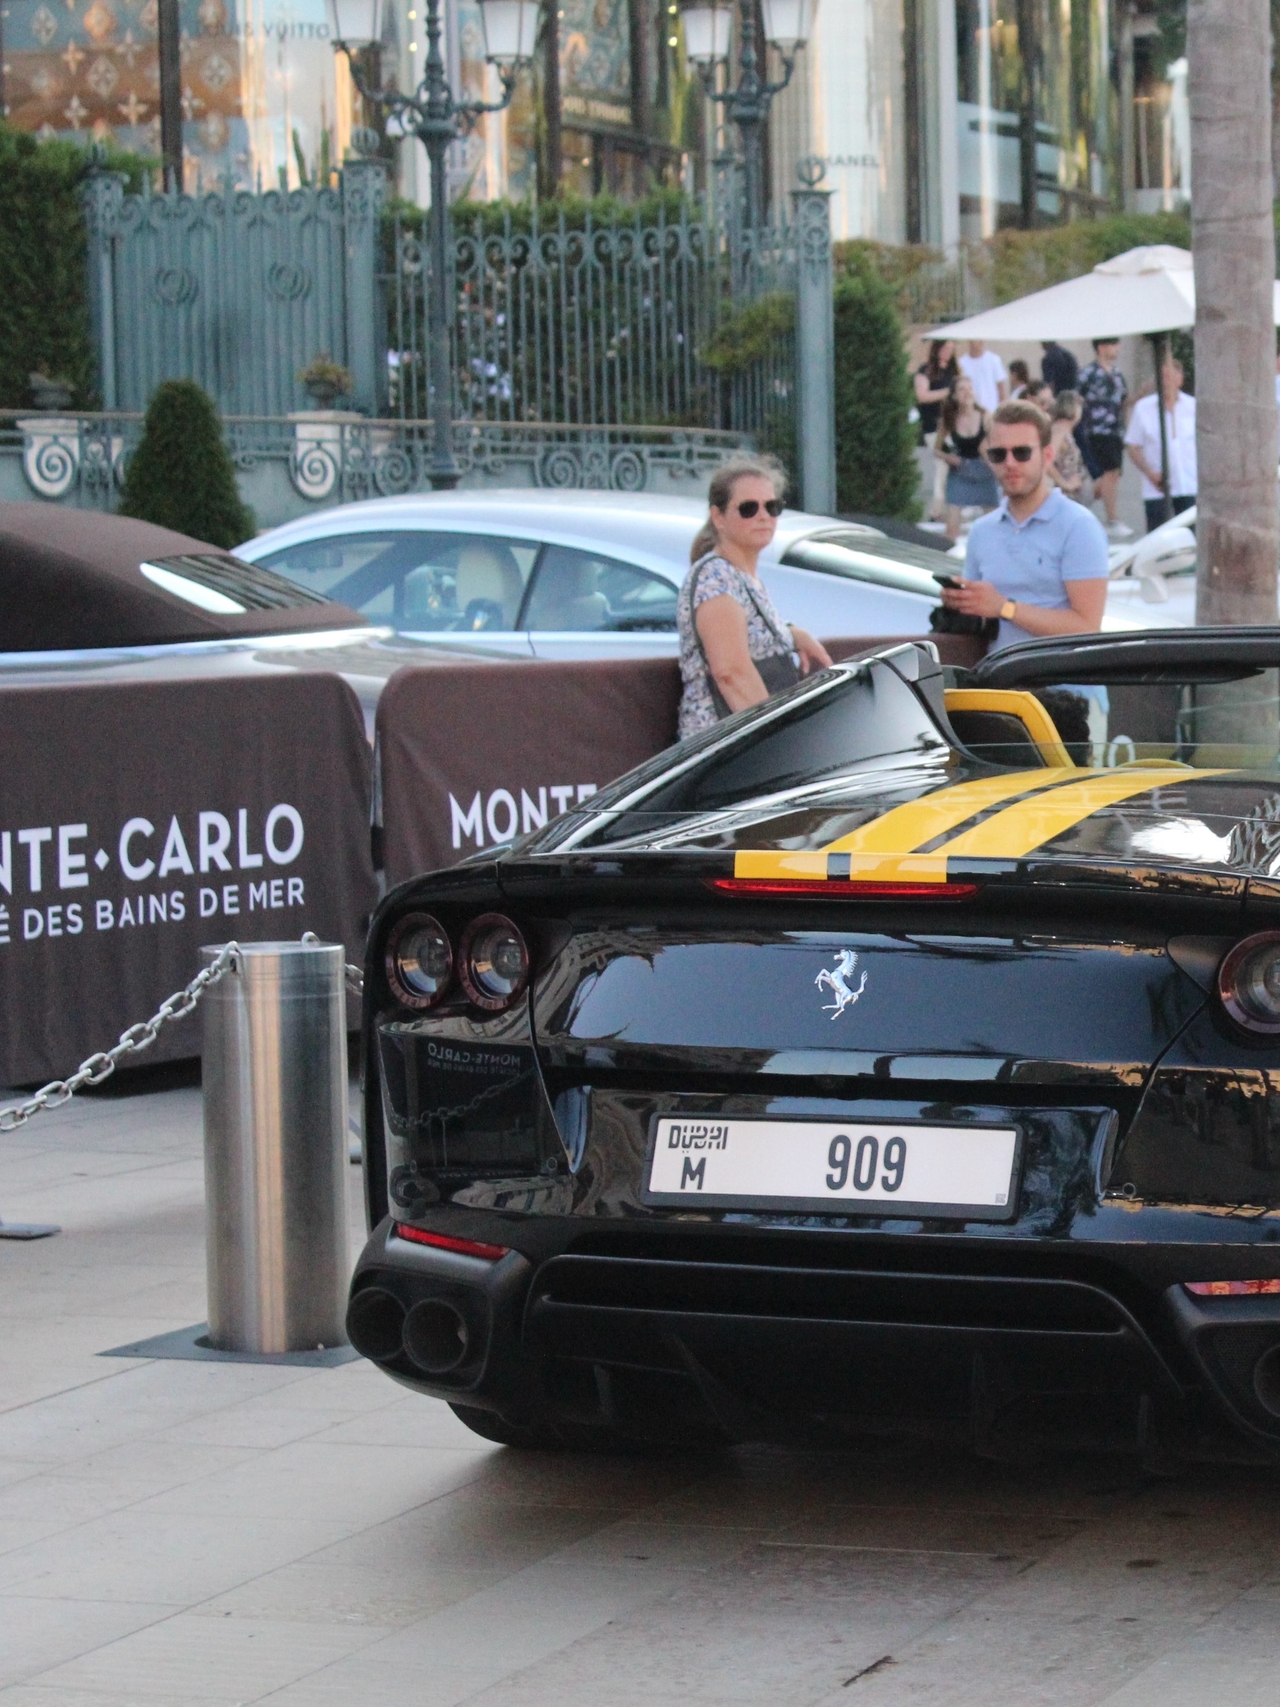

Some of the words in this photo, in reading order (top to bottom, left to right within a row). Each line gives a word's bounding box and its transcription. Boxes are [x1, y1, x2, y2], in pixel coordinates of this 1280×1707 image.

[24, 903, 83, 940] DES
[96, 891, 186, 930] BAINS
[200, 885, 240, 917] DE
[250, 877, 304, 911] MER
[680, 1156, 707, 1191] M
[825, 1134, 907, 1193] 909
